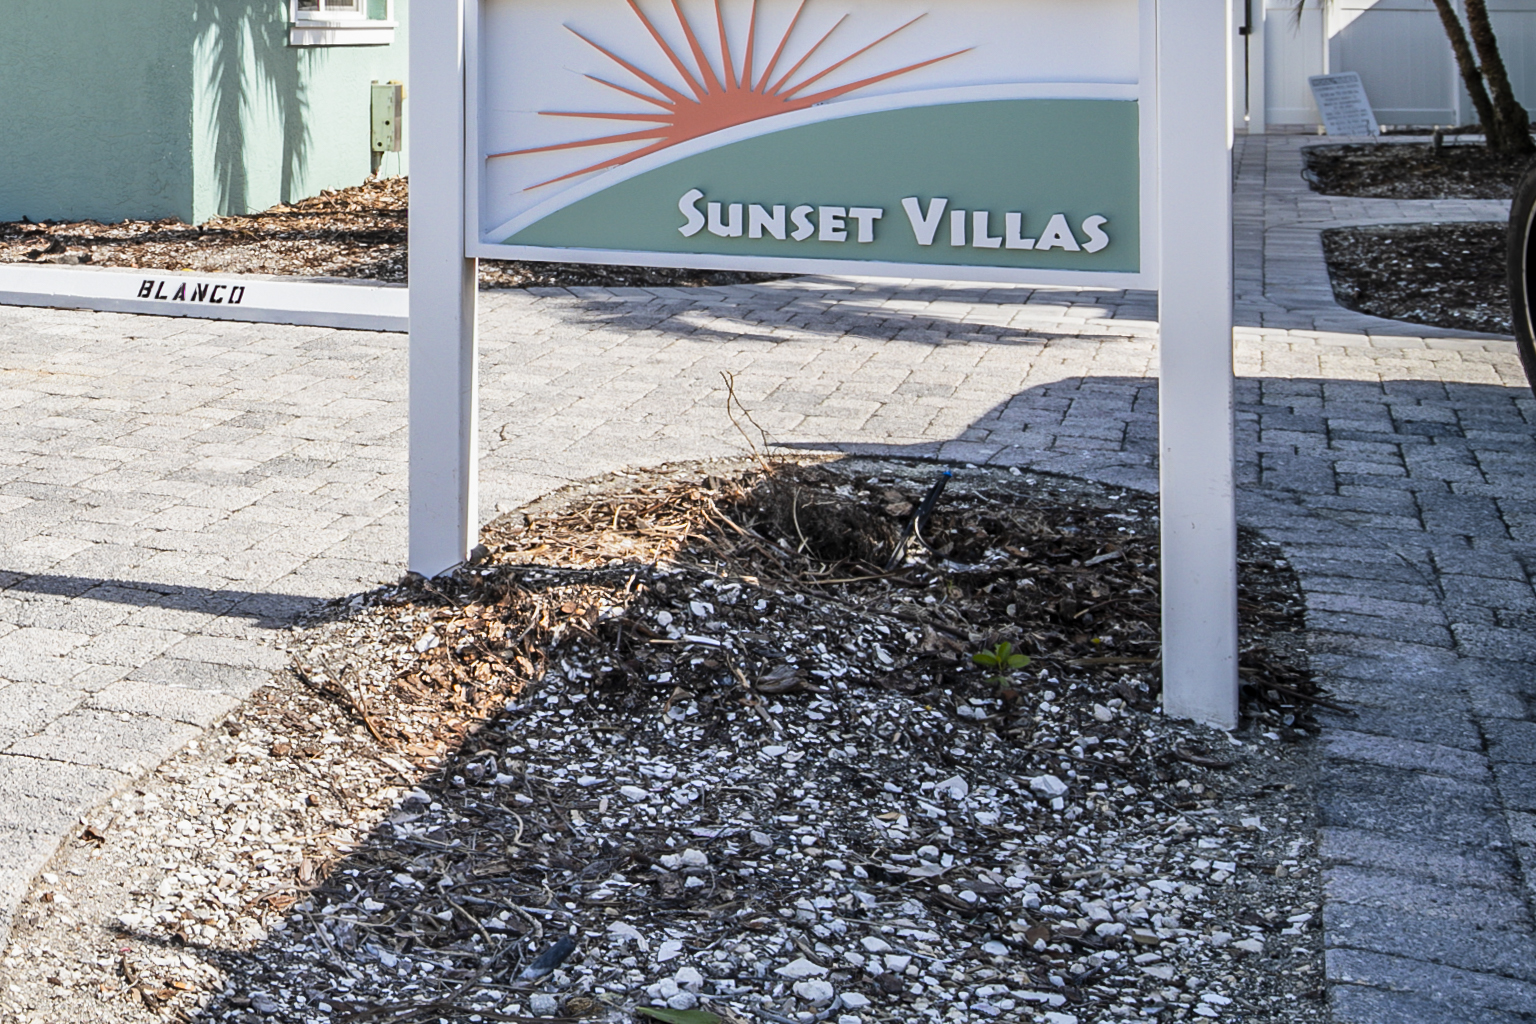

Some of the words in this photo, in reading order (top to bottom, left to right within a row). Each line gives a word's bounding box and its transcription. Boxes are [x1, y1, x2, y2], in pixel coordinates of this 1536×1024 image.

[677, 188, 884, 244] SUNSET
[901, 196, 1110, 254] VILLAS
[137, 279, 246, 305] BLANCO
